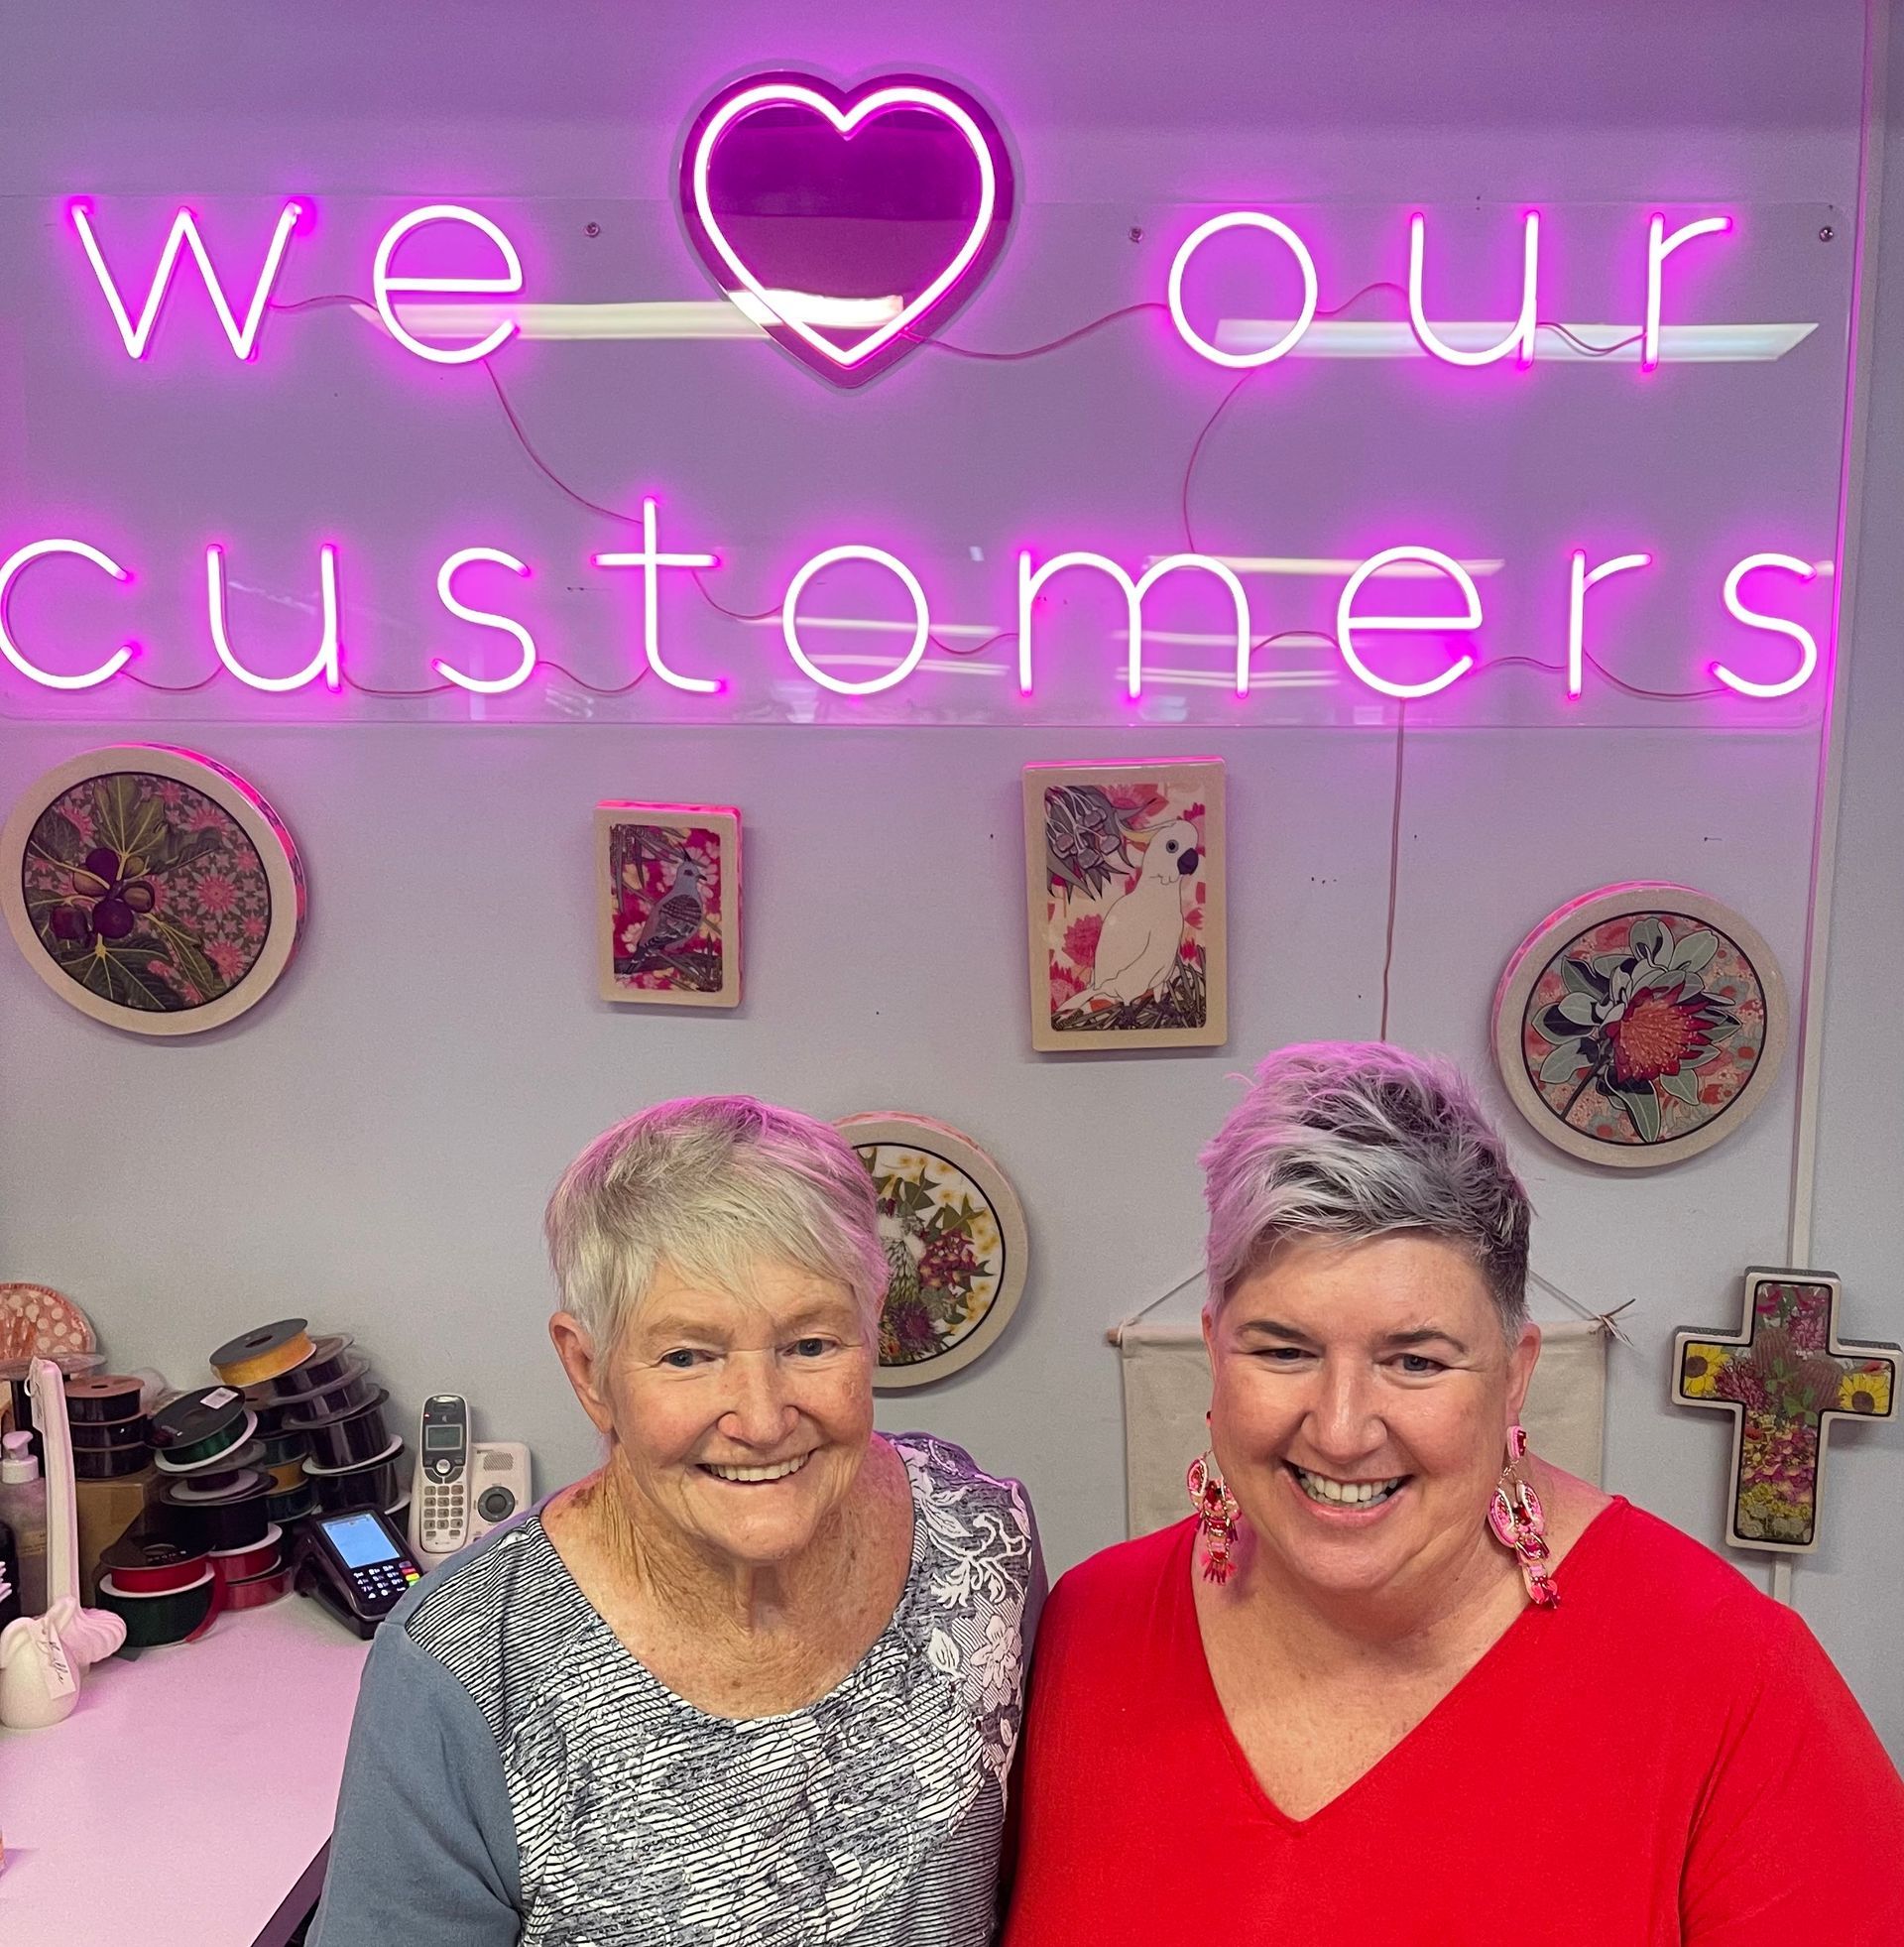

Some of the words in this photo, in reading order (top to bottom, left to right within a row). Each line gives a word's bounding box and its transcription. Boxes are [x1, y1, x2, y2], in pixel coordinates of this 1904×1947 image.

[71, 201, 524, 364] we
[1167, 210, 1732, 370] our
[0, 496, 1819, 699] customers
